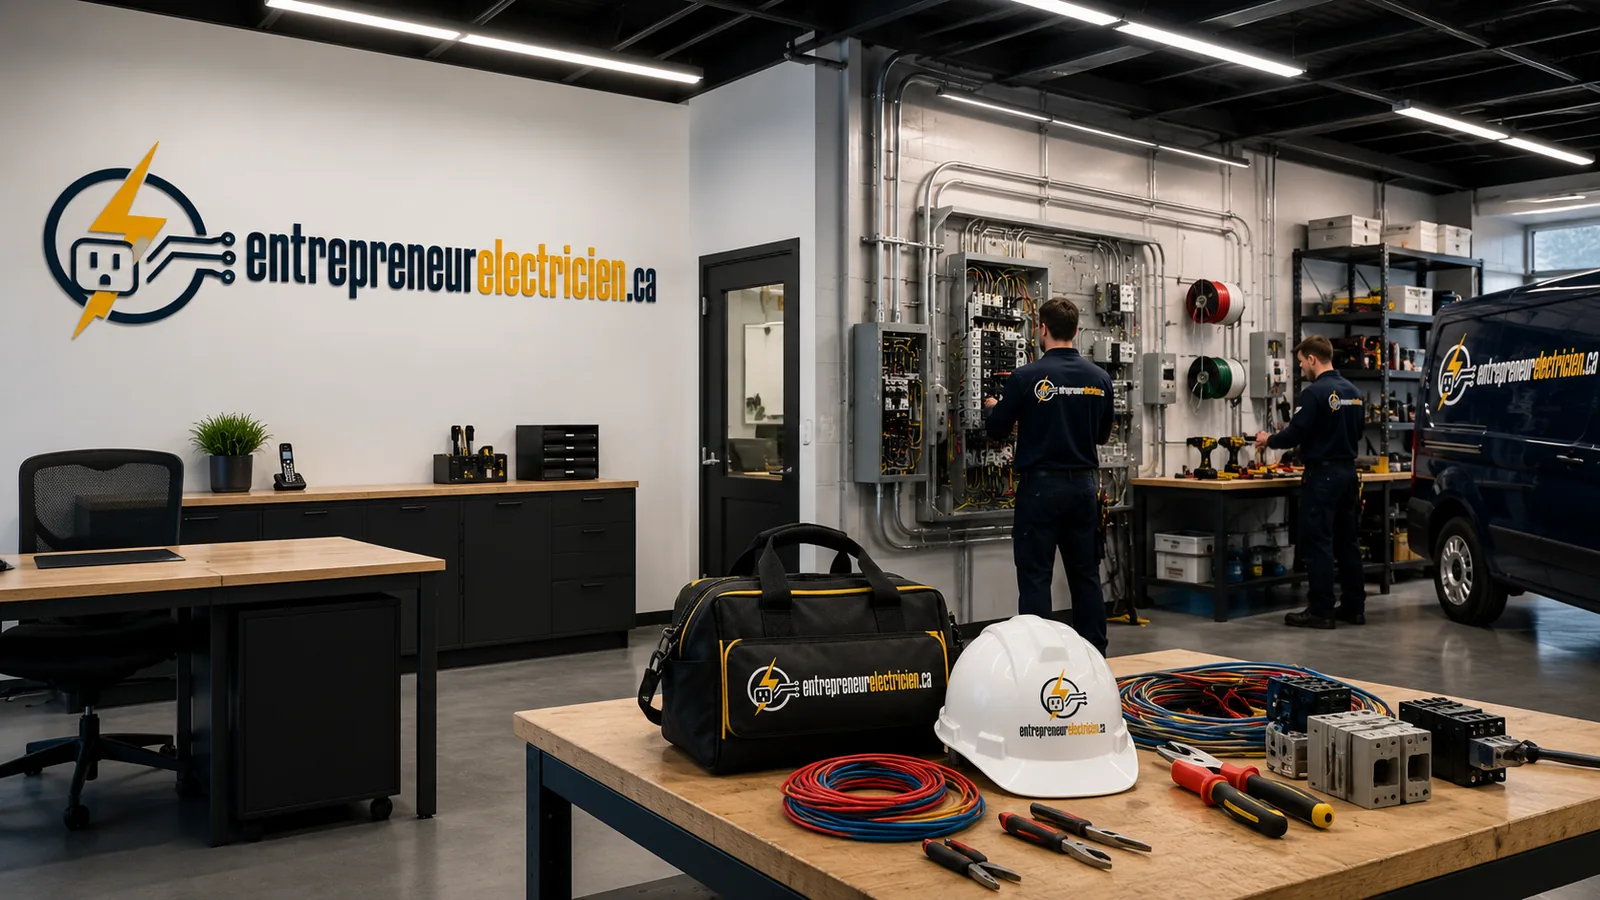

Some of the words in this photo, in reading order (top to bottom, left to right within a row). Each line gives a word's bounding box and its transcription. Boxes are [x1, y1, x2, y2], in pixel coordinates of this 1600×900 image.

[246, 223, 657, 303] entrepreneurelectricien.ca
[1476, 347, 1599, 387] entrepreneurelectricien.ca
[802, 669, 932, 698] entrepreneurelectricien.ca
